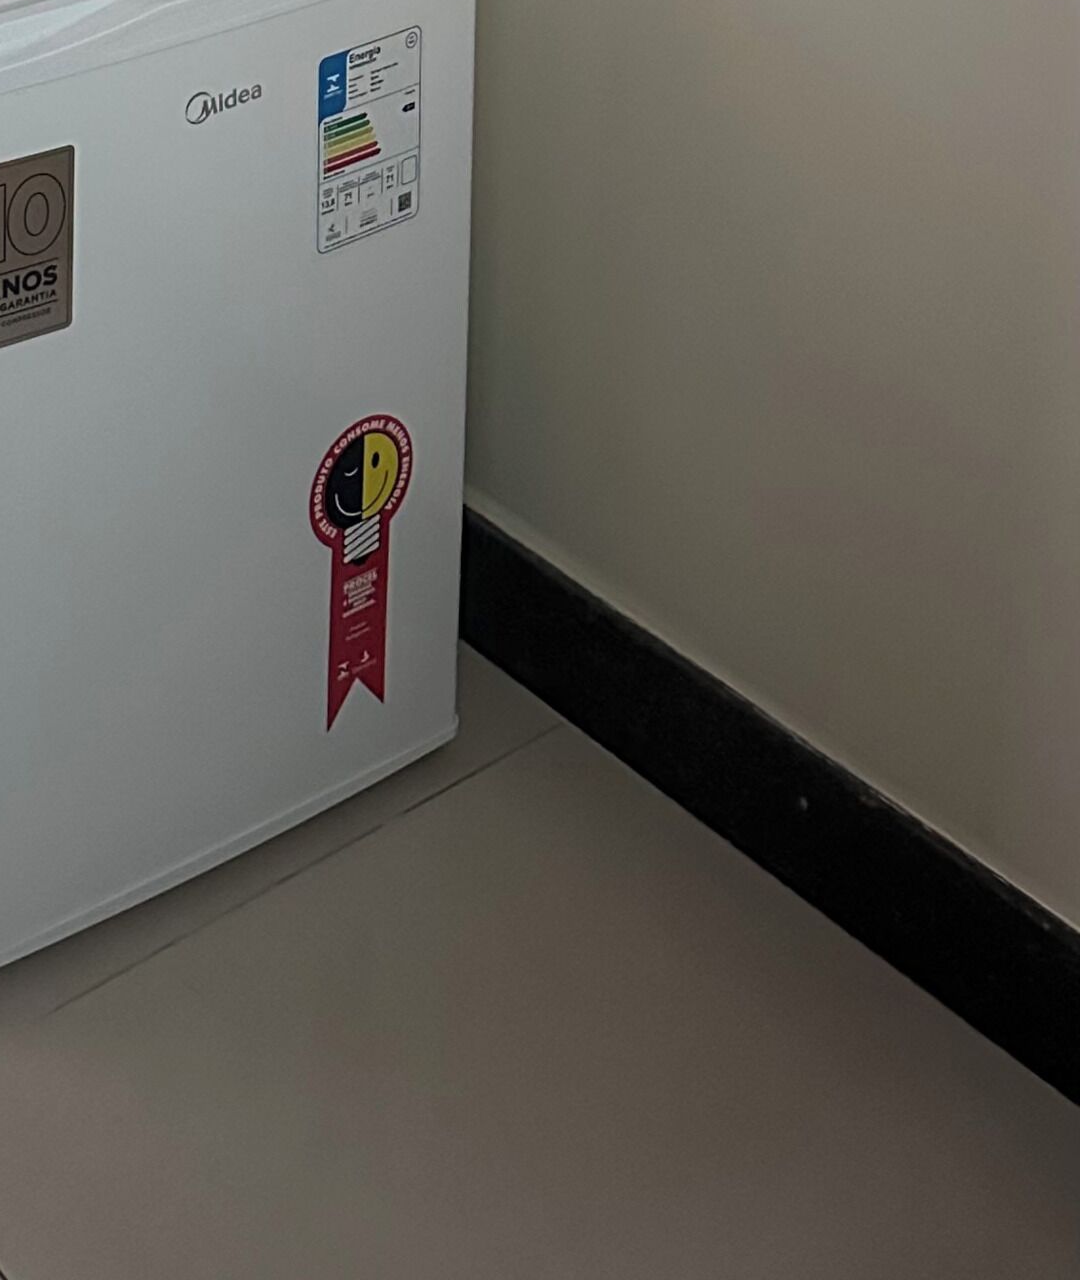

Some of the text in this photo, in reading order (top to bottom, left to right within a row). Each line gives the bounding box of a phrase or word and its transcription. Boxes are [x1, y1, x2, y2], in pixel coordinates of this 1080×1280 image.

[349, 46, 381, 63] Energia
[185, 84, 262, 125] Midea
[0, 289, 57, 312] GARANTIA
[334, 420, 386, 454] CONSOME
